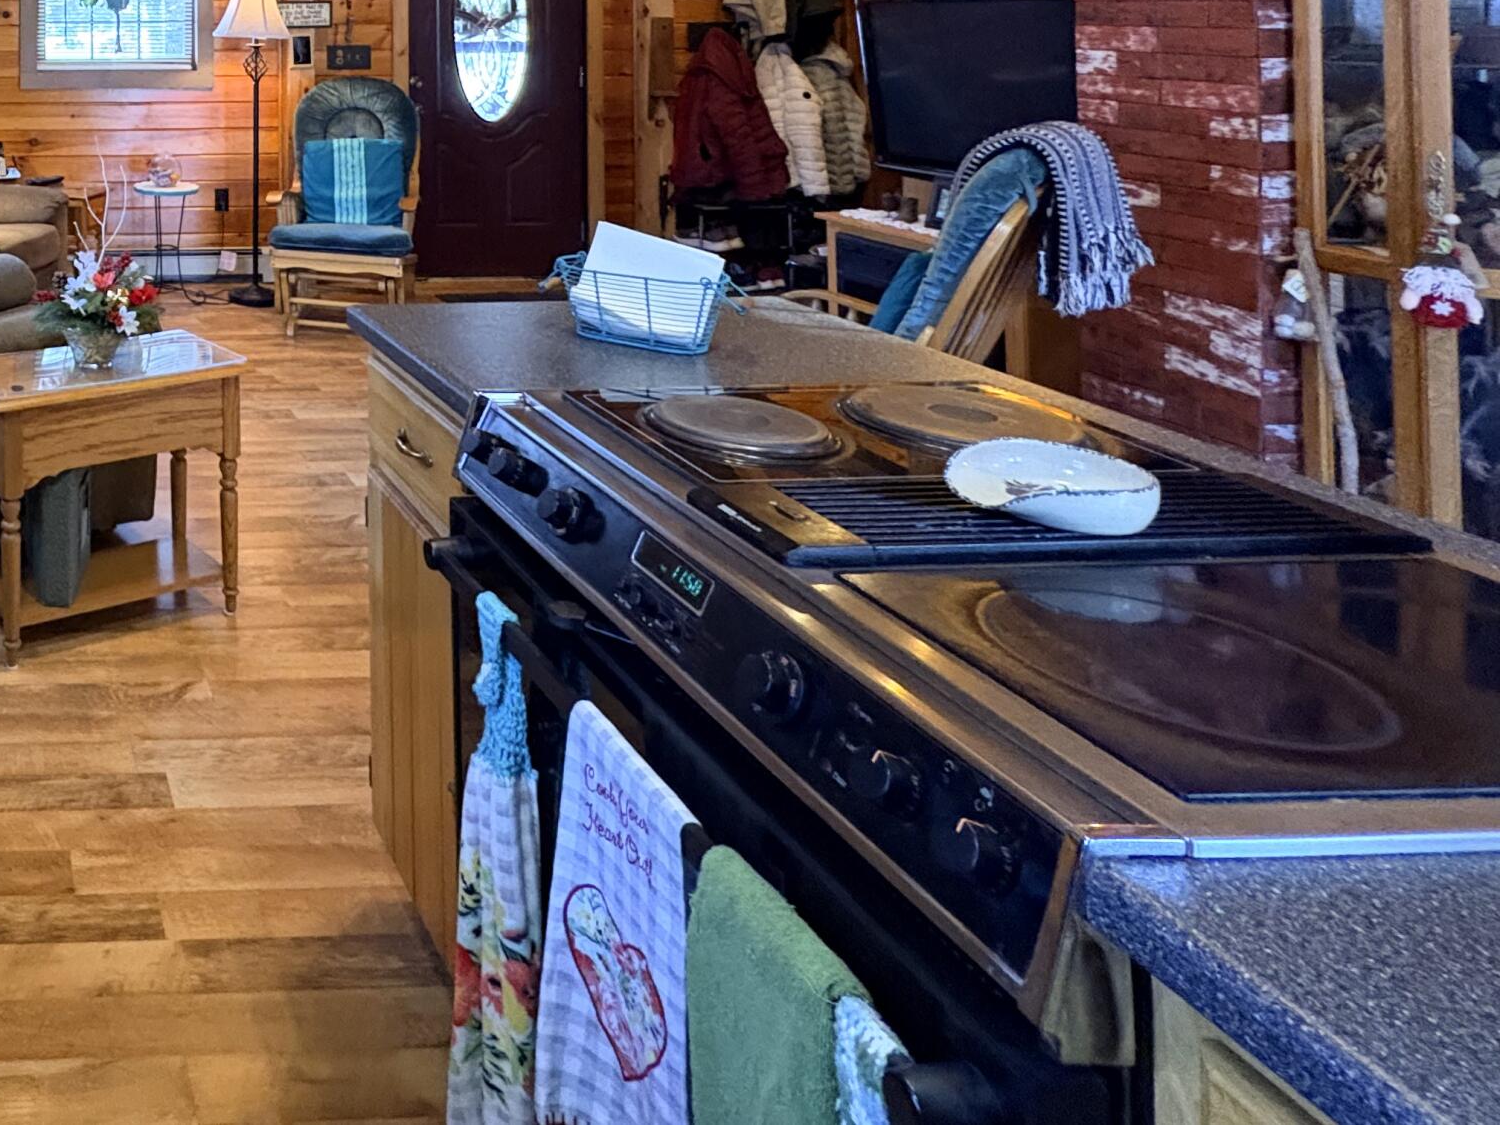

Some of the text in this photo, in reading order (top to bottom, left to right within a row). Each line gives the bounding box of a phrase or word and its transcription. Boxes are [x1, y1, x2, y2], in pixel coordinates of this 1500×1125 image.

[582, 801, 624, 851] Heart
[584, 763, 649, 835] Cook Your
